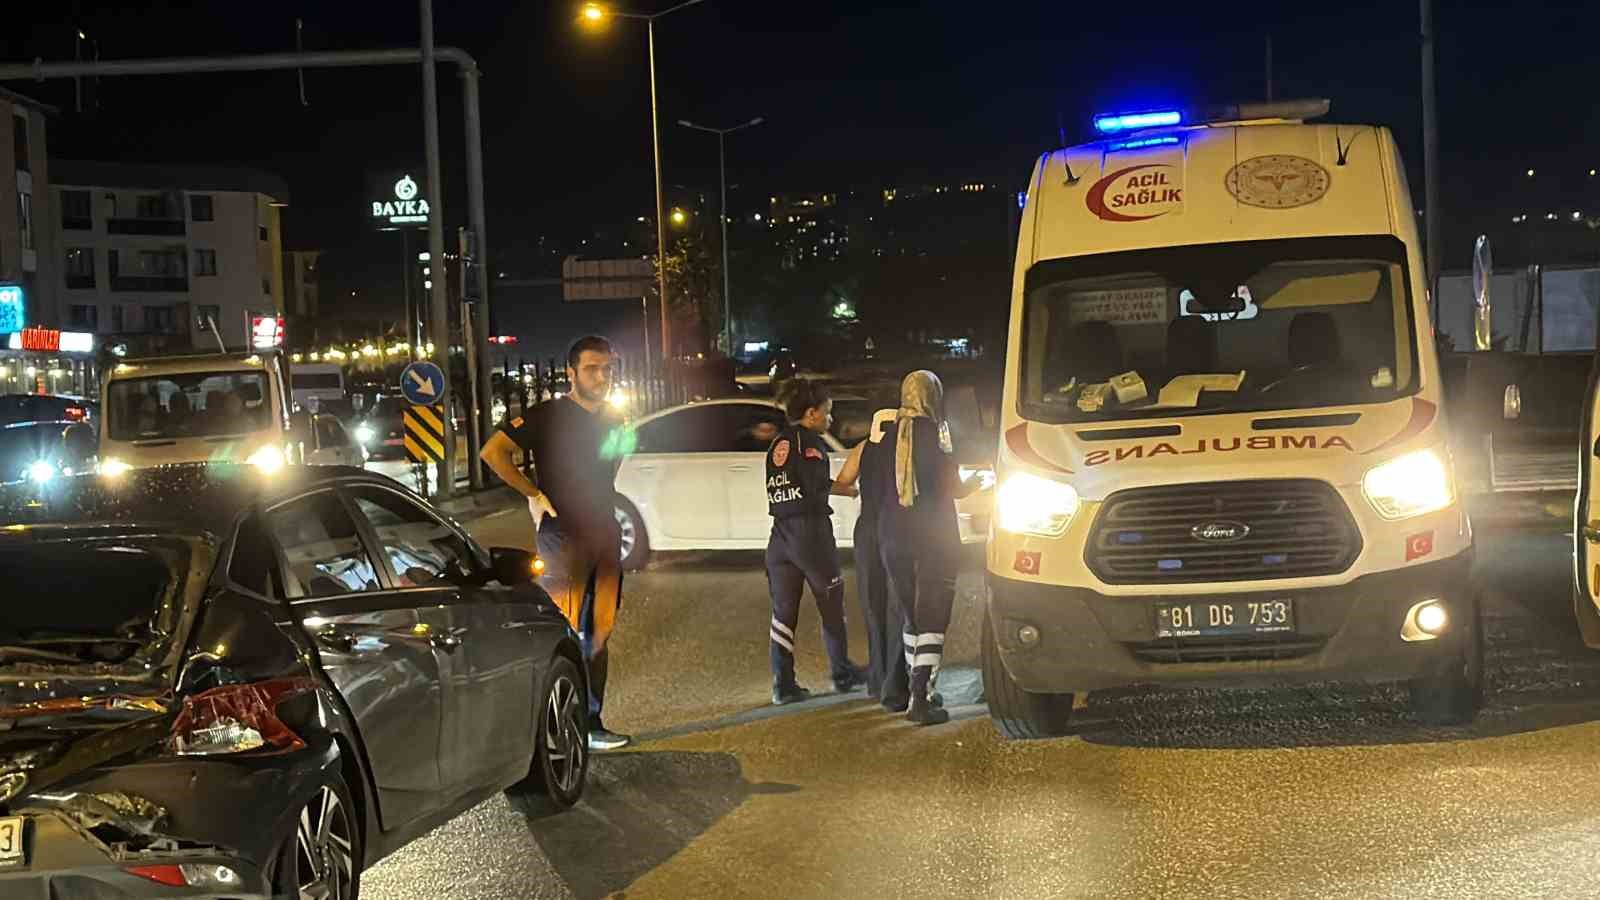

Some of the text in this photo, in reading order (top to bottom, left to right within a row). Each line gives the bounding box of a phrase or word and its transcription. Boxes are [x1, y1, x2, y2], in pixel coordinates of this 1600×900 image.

[1126, 171, 1170, 189] ACİL
[1111, 188, 1183, 208] SAĞLIK
[767, 471, 791, 488] ACİL
[767, 486, 803, 504] AĞLIK
[1171, 602, 1287, 628] 81 DG 753
